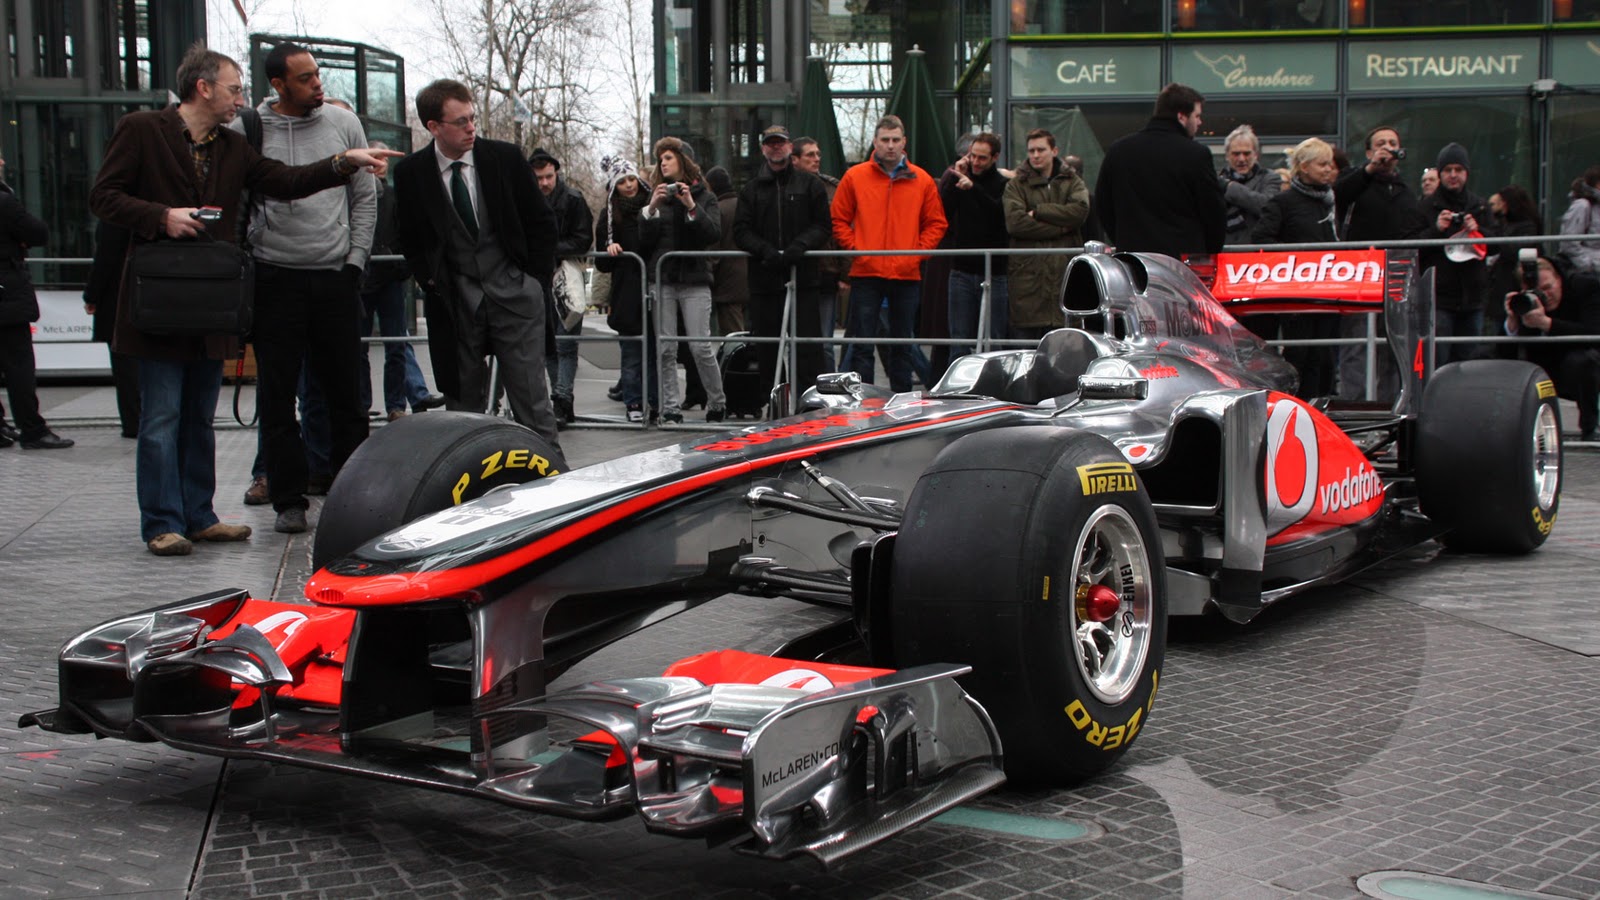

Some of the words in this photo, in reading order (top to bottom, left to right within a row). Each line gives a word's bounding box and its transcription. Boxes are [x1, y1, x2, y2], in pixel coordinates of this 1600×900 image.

[1056, 58, 1118, 84] CAFÉ
[1224, 67, 1315, 89] Corroboree
[1366, 53, 1522, 78] RESTAURANT
[1225, 253, 1384, 284] vodafon
[1413, 338, 1424, 380] 4
[1076, 462, 1138, 496] PIRELLI
[1064, 699, 1143, 751] ZERO
